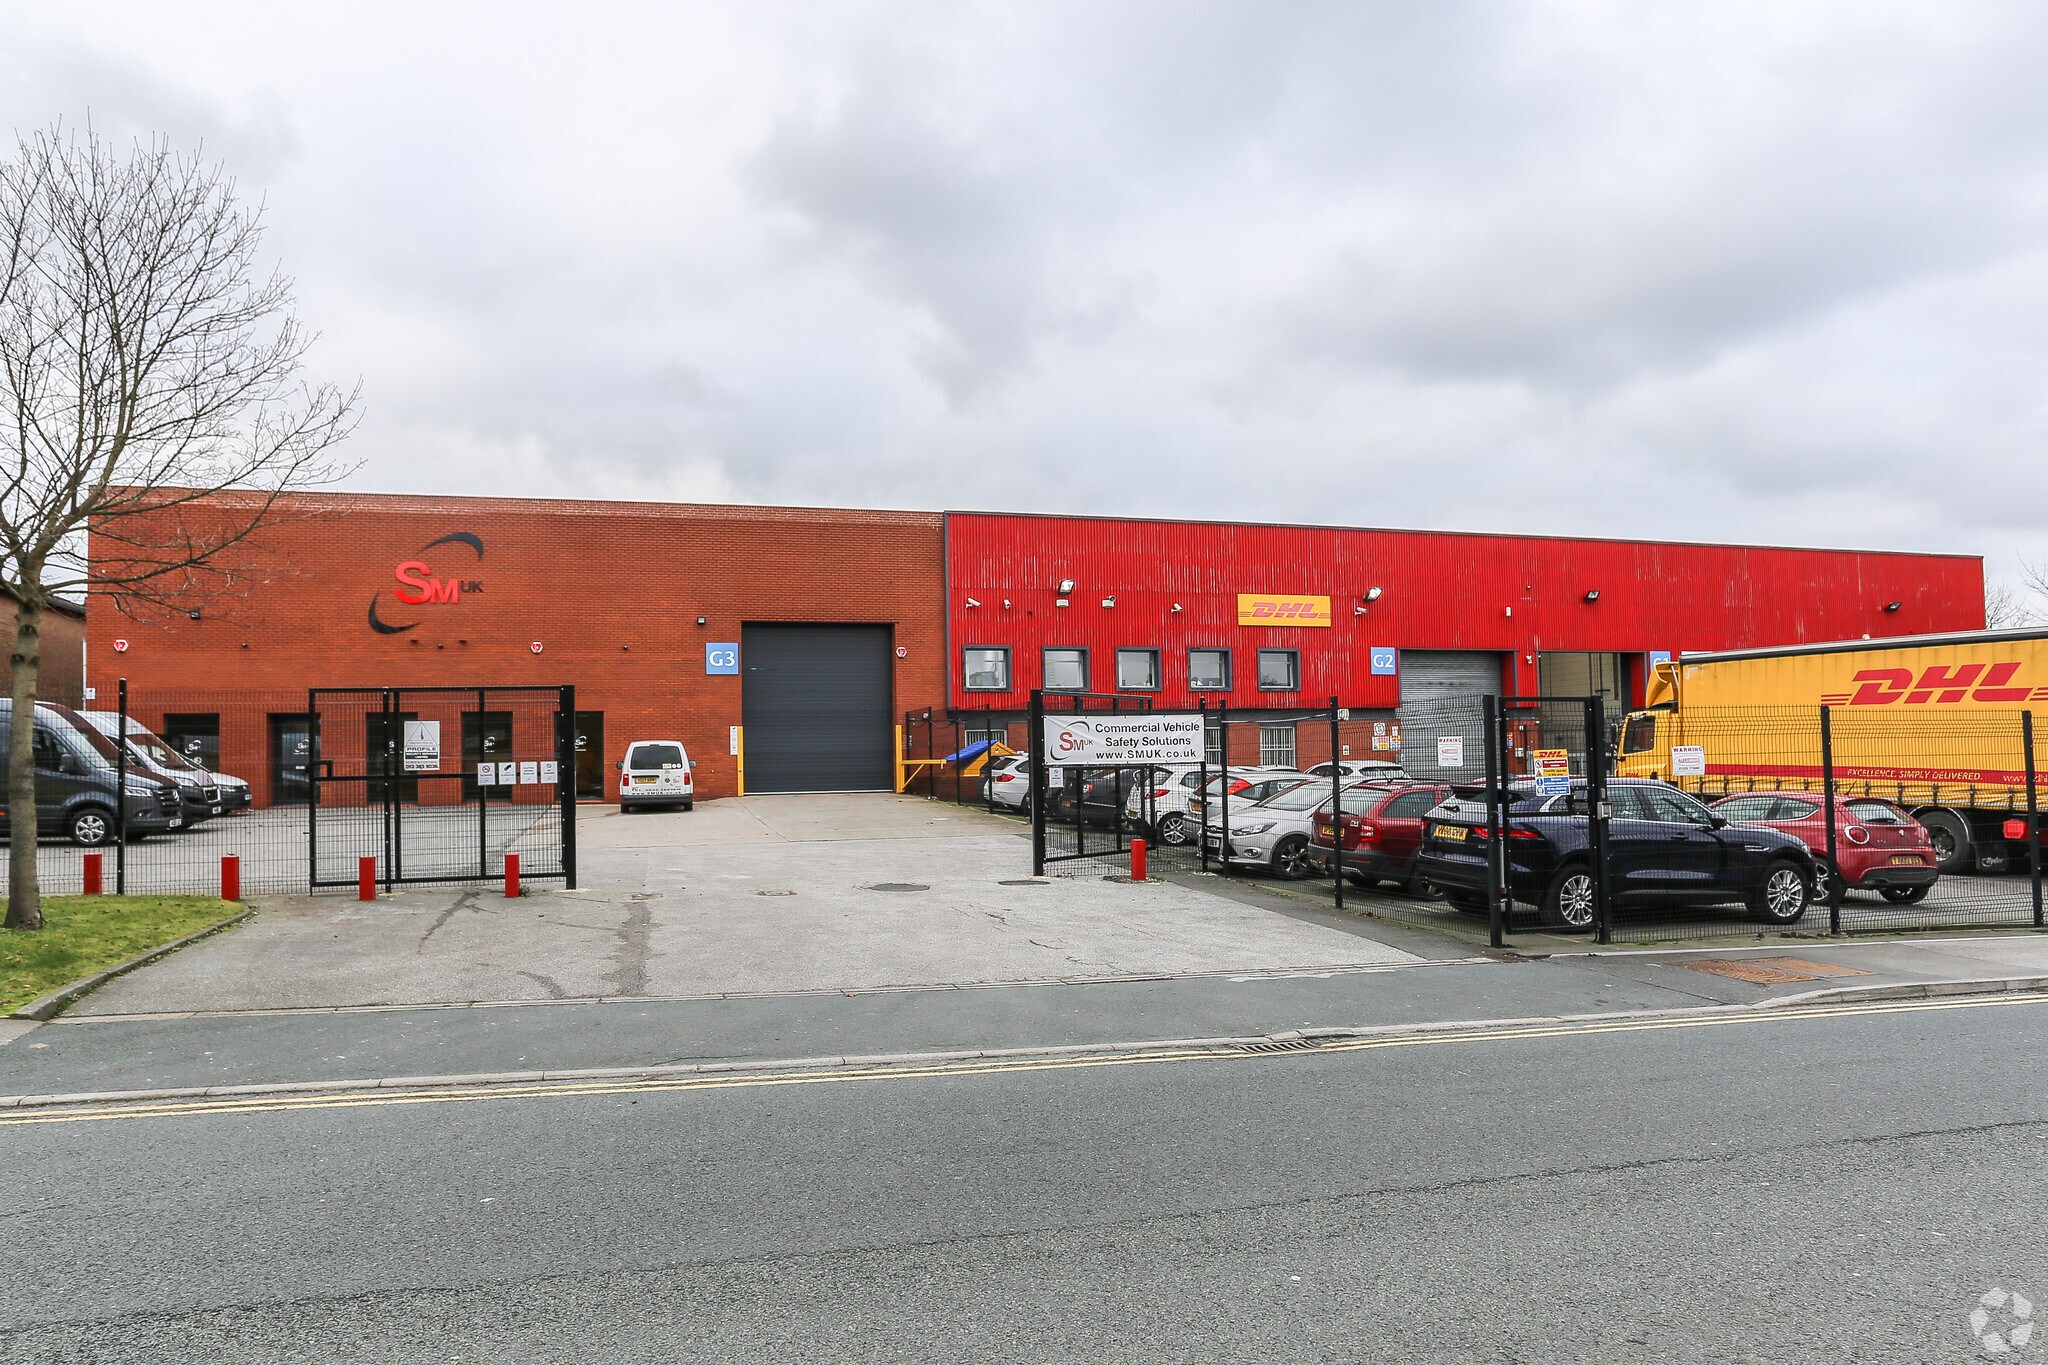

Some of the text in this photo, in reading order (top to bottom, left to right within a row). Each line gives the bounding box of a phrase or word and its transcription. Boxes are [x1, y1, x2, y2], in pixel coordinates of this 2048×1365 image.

[1252, 602, 1319, 618] DHL
[709, 650, 736, 667] G3
[1373, 654, 1394, 668] G2
[1849, 662, 2033, 705] DHL
[1095, 722, 1200, 733] Commercial Vehicle
[1105, 737, 1191, 748] Safety Solutions
[1096, 749, 1196, 759] www.SMUK.co.uk
[1847, 768, 1983, 781] EXCELLENCE. SIMPLY DELIVERED.
